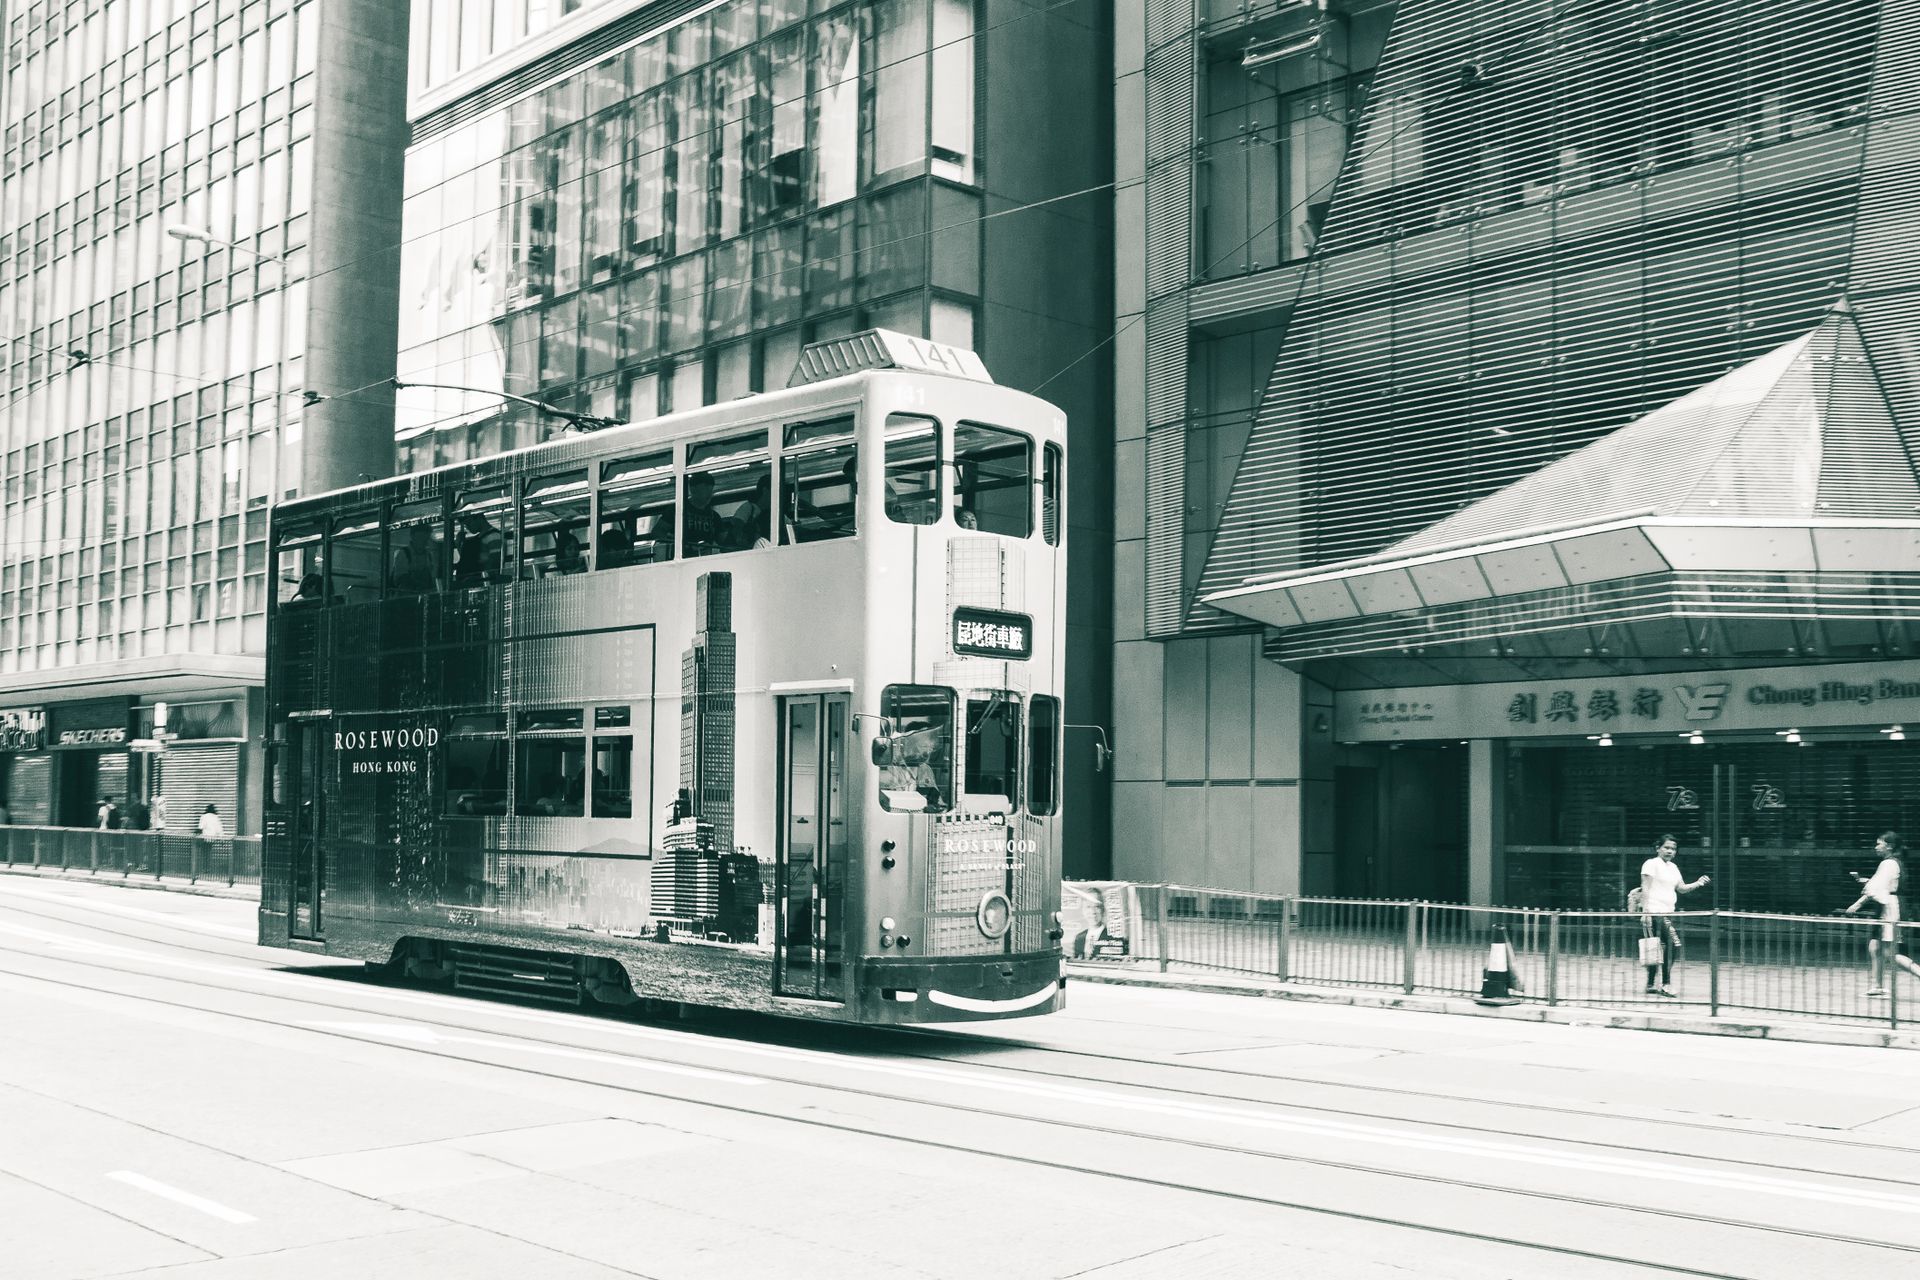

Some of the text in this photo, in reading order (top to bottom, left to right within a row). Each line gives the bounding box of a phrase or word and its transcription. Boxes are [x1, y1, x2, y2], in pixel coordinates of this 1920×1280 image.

[907, 337, 967, 376] 141
[1747, 684, 1817, 707] Chong
[1819, 681, 1874, 705] Hing
[58, 727, 126, 745] SKECHERS
[334, 728, 439, 750] ROSEWOOD
[352, 760, 417, 774] HONG KONG
[944, 839, 1037, 854] ROSEWOOD
